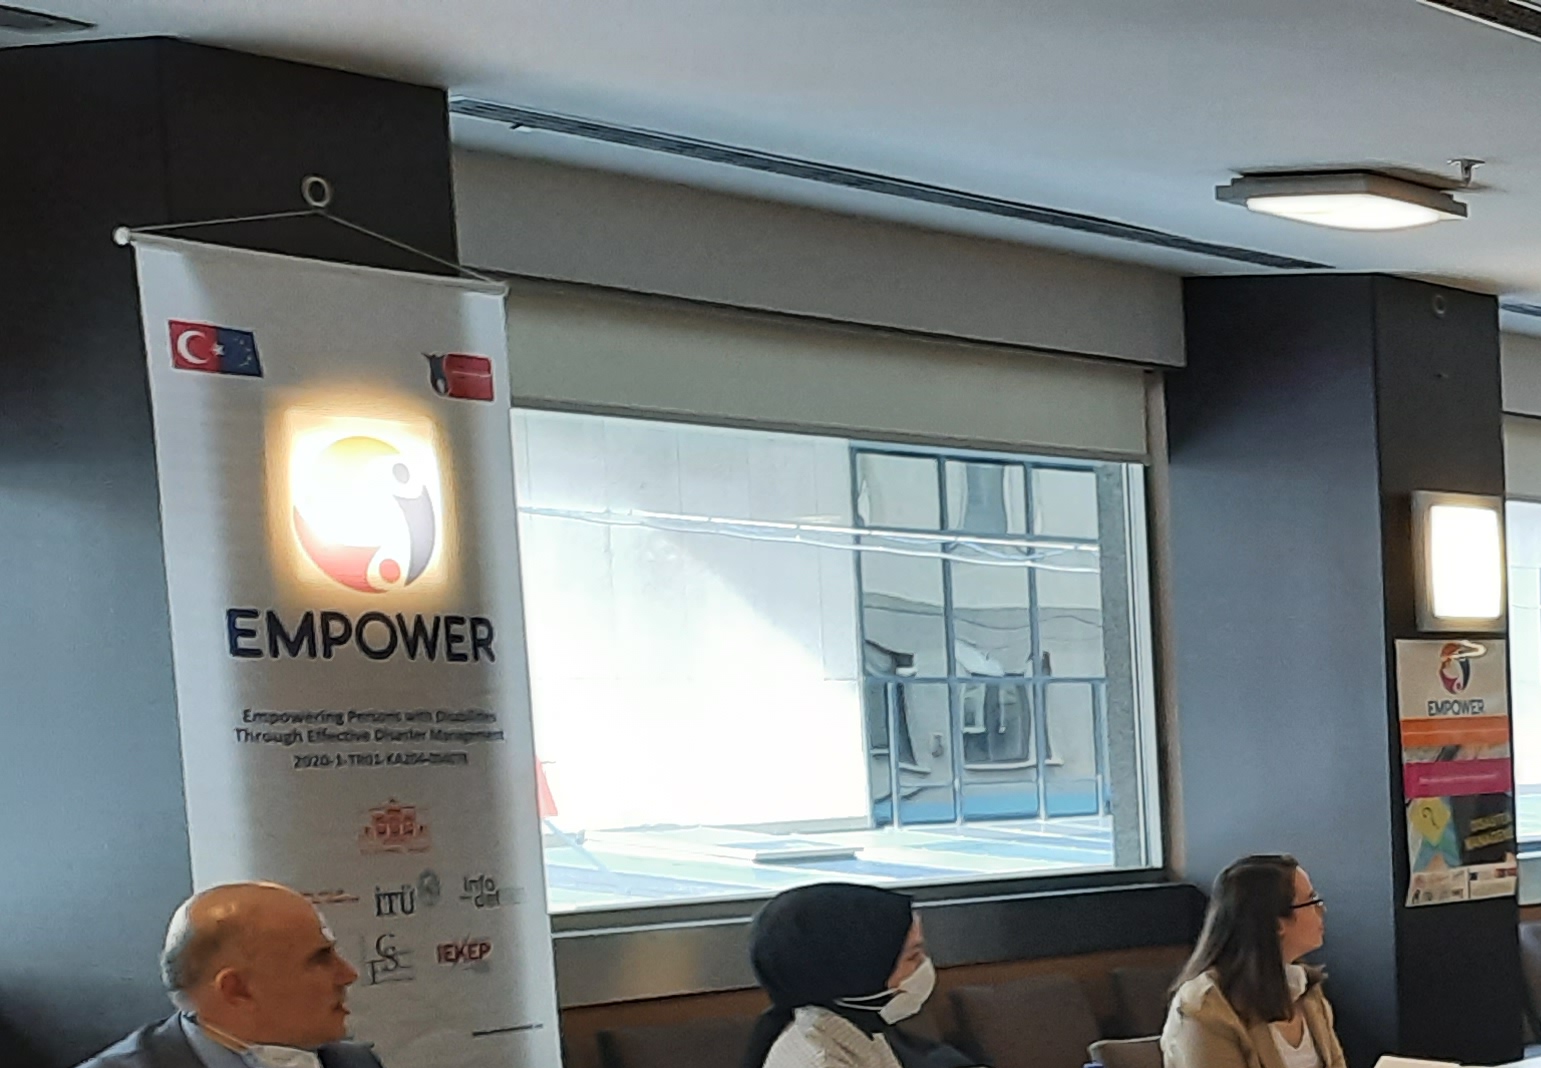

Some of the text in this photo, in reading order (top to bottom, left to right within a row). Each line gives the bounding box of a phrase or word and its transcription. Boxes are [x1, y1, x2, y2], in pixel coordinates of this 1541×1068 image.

[226, 609, 496, 663] EMPOWER
[1428, 699, 1484, 716] EMPOWER
[375, 884, 416, 917] İTÜ
